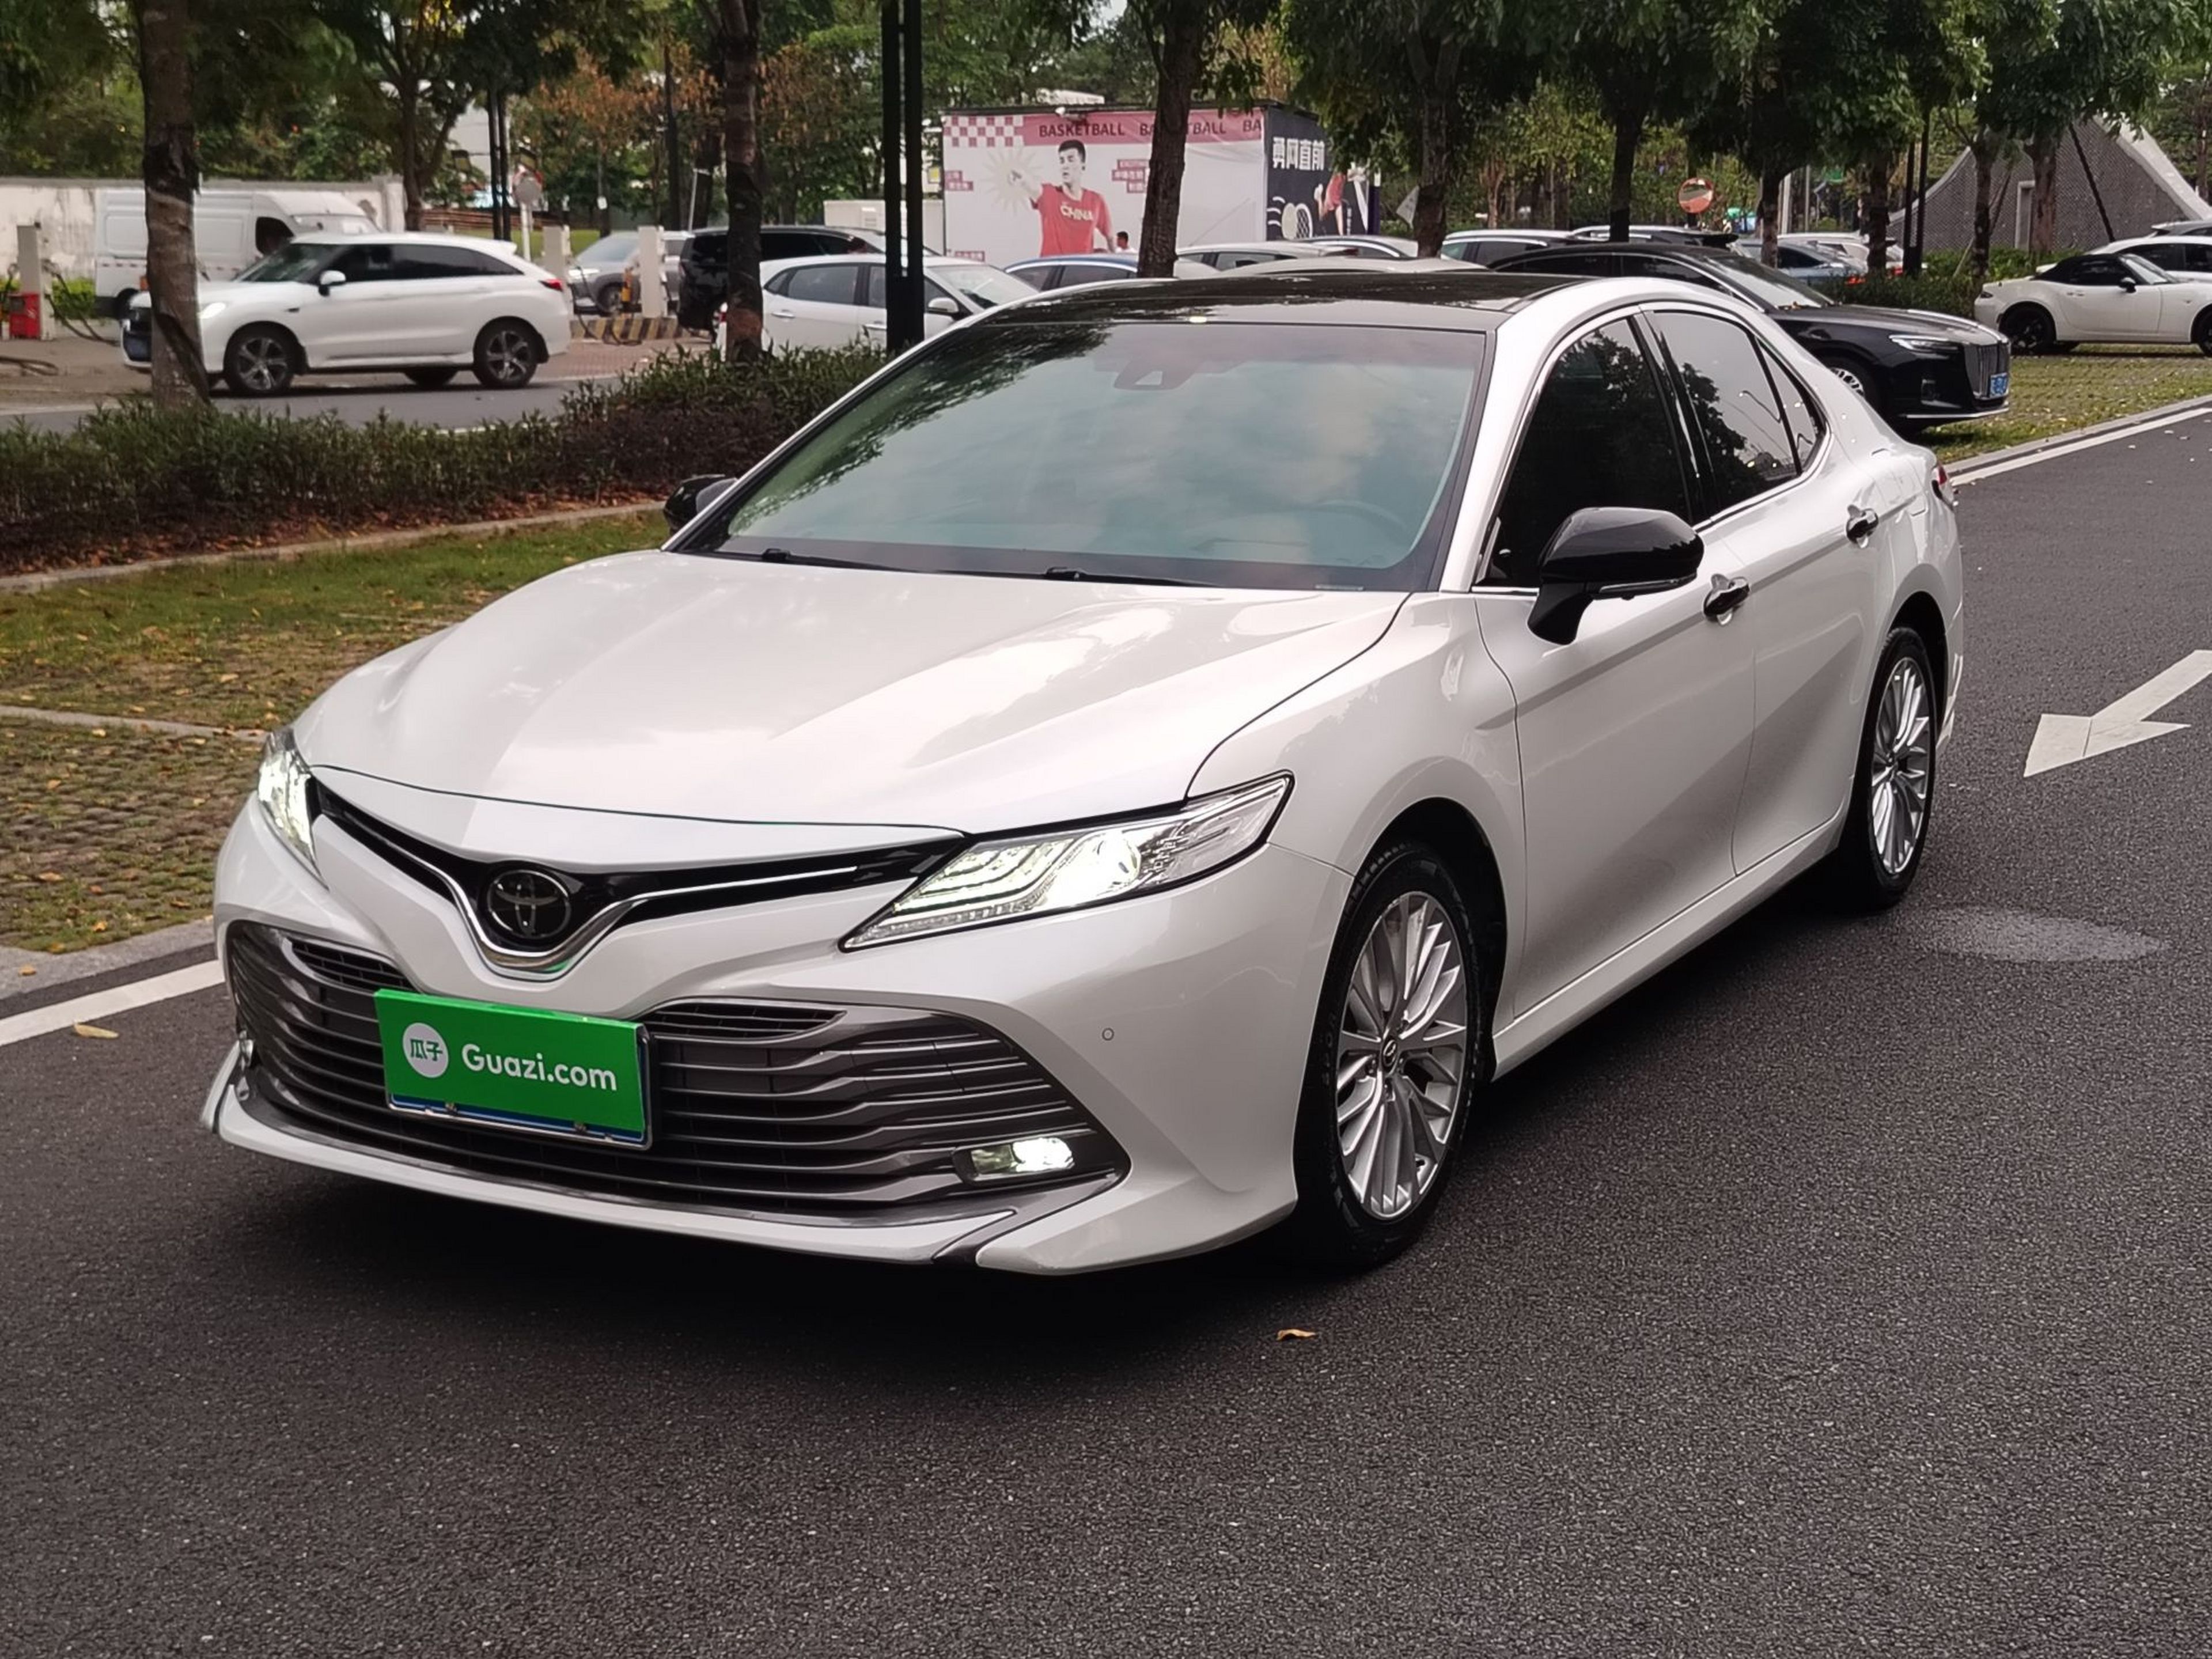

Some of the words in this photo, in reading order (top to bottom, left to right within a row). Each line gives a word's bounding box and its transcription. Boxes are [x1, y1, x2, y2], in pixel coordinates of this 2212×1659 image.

[1039, 123, 1124, 138] BASKETBALL
[1140, 122, 1227, 137] BBALL
[1060, 204, 1094, 221] CHINA
[410, 1038, 443, 1062] 瓜子
[461, 1043, 617, 1091] Guazi.com
